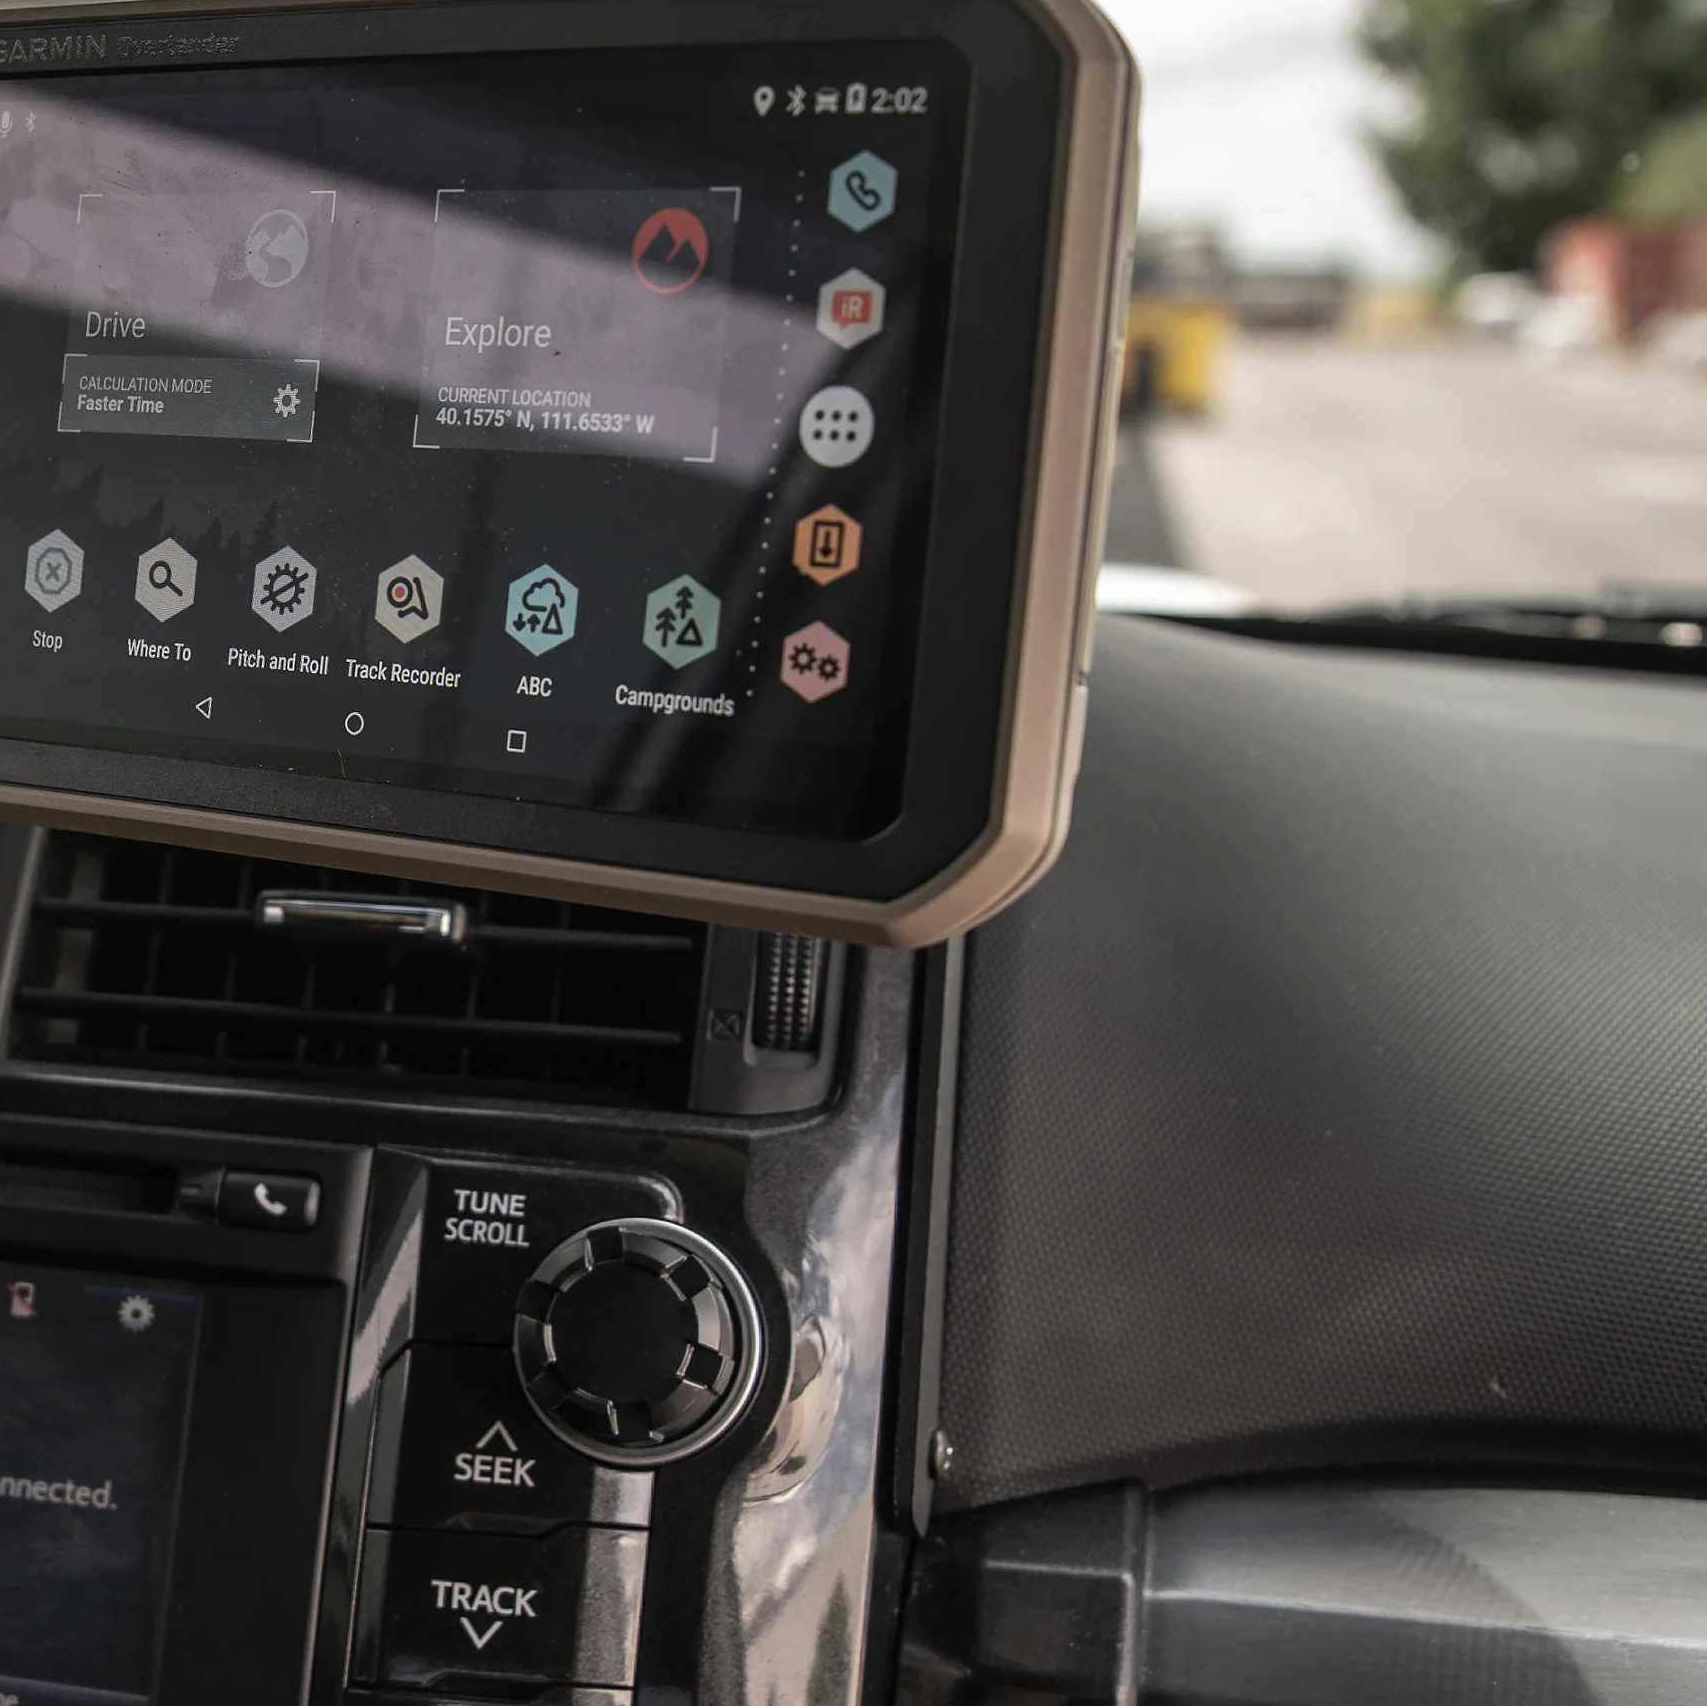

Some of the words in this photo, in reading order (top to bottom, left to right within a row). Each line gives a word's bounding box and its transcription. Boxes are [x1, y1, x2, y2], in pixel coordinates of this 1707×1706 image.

[870, 87, 929, 114] 2:02
[85, 310, 146, 339] Drive
[445, 316, 552, 354] Explore
[79, 376, 169, 393] CALCULATION
[171, 378, 213, 394] MODE
[437, 386, 509, 406] CURRENT
[511, 389, 592, 408] LOCATION
[77, 394, 124, 412] Faster
[127, 395, 165, 414] Time
[435, 407, 512, 428] 40.1575°
[516, 410, 536, 432] N,
[541, 410, 631, 433] 111.6533°
[635, 413, 656, 435] W
[32, 629, 64, 653] Stop
[127, 638, 170, 659] Where
[174, 642, 192, 662] To
[227, 647, 265, 669] Pitch
[269, 652, 297, 672] and
[299, 654, 330, 676] Roll
[346, 658, 387, 681] Track
[390, 663, 462, 689] Recorder
[516, 675, 553, 698] ABC
[615, 684, 736, 717] Campgrounds
[453, 1188, 527, 1218] TUNE
[443, 1216, 531, 1249] SCROLL
[453, 1452, 537, 1488] SEEK
[430, 1578, 538, 1618] TRACK
